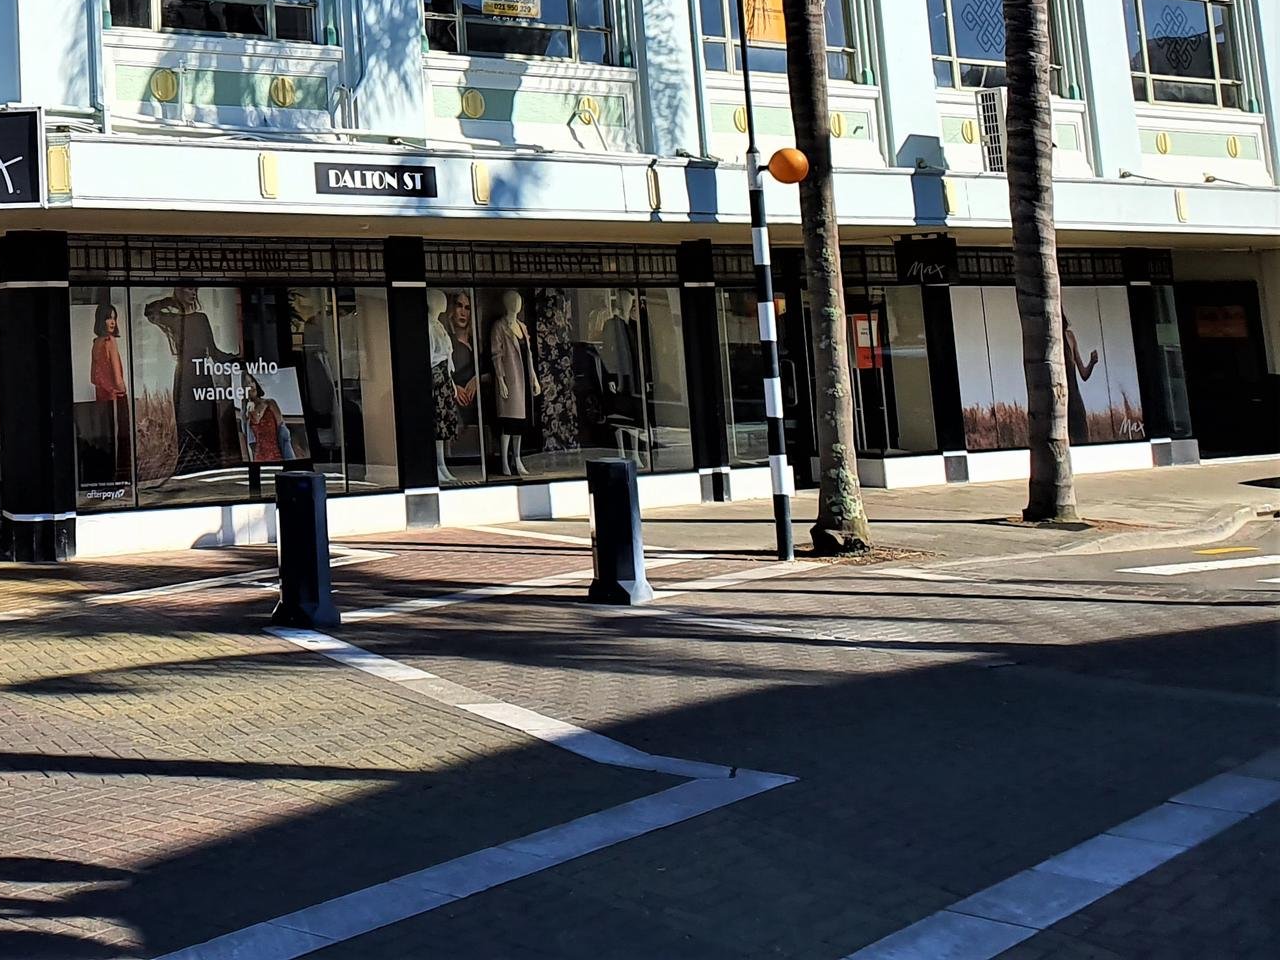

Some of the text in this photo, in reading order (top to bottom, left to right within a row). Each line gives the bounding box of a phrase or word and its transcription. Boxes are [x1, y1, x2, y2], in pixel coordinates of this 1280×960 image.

[328, 169, 424, 190] DALTON ST
[907, 261, 945, 282] Max
[191, 356, 279, 376] Those who
[192, 385, 252, 401] wander
[1119, 415, 1146, 440] Max
[86, 490, 114, 500] afterpay
